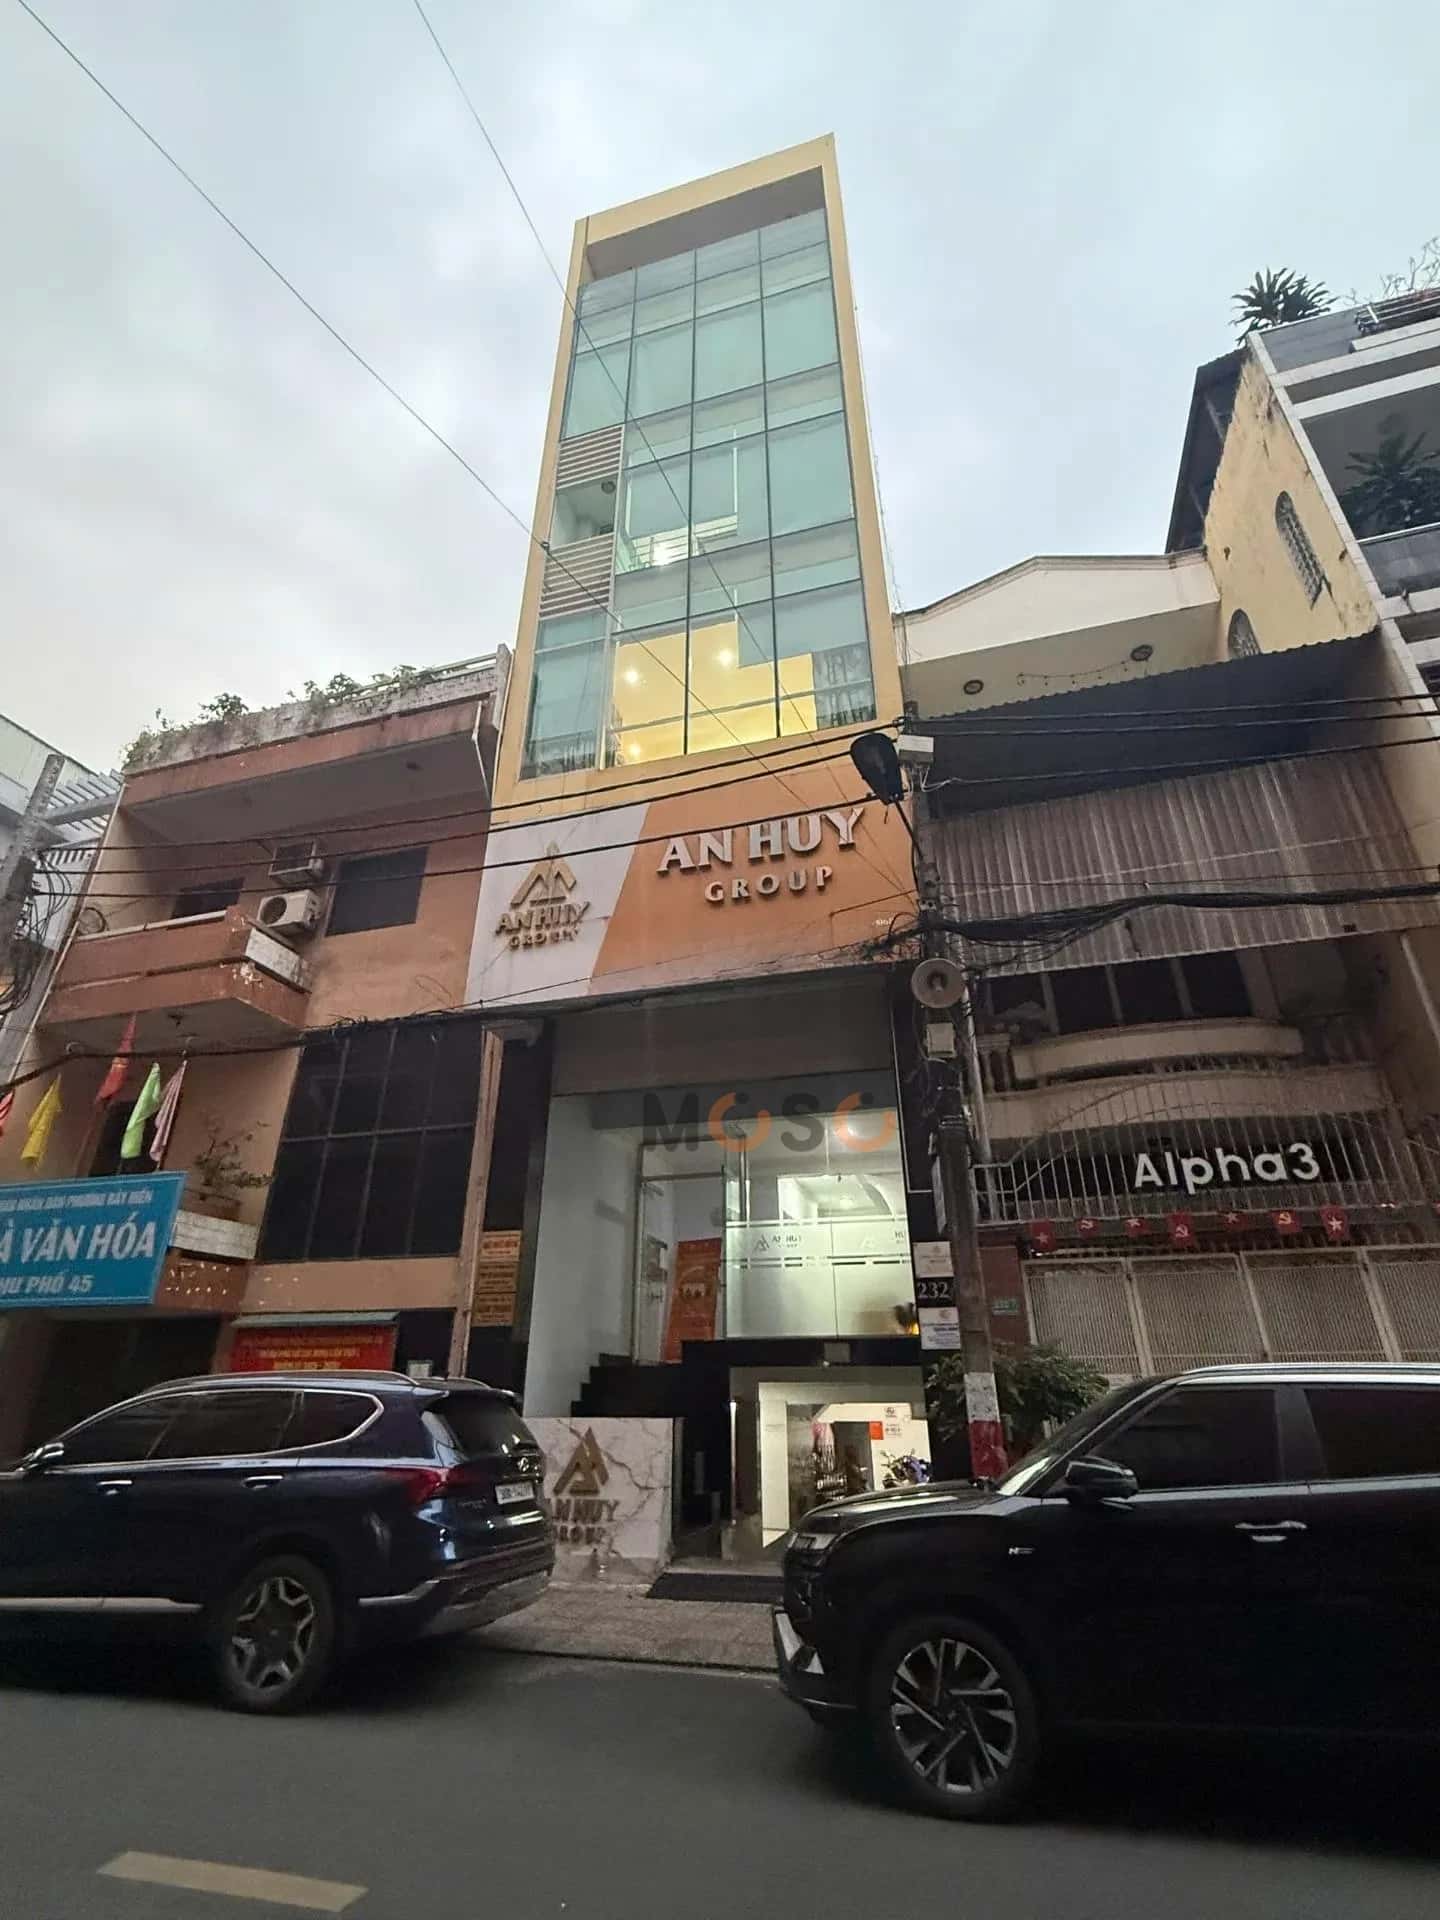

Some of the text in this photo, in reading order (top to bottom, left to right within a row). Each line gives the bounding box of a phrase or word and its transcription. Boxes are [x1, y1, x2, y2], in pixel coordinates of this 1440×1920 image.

[656, 807, 865, 875] AN HUY
[704, 864, 833, 903] GROUP
[495, 901, 590, 935] AN HUY
[1134, 1143, 1320, 1195] Alpha3
[21, 1218, 86, 1264] VĂN
[86, 1211, 156, 1260] HÓA
[69, 1274, 94, 1293] 45
[918, 1281, 949, 1299] 232
